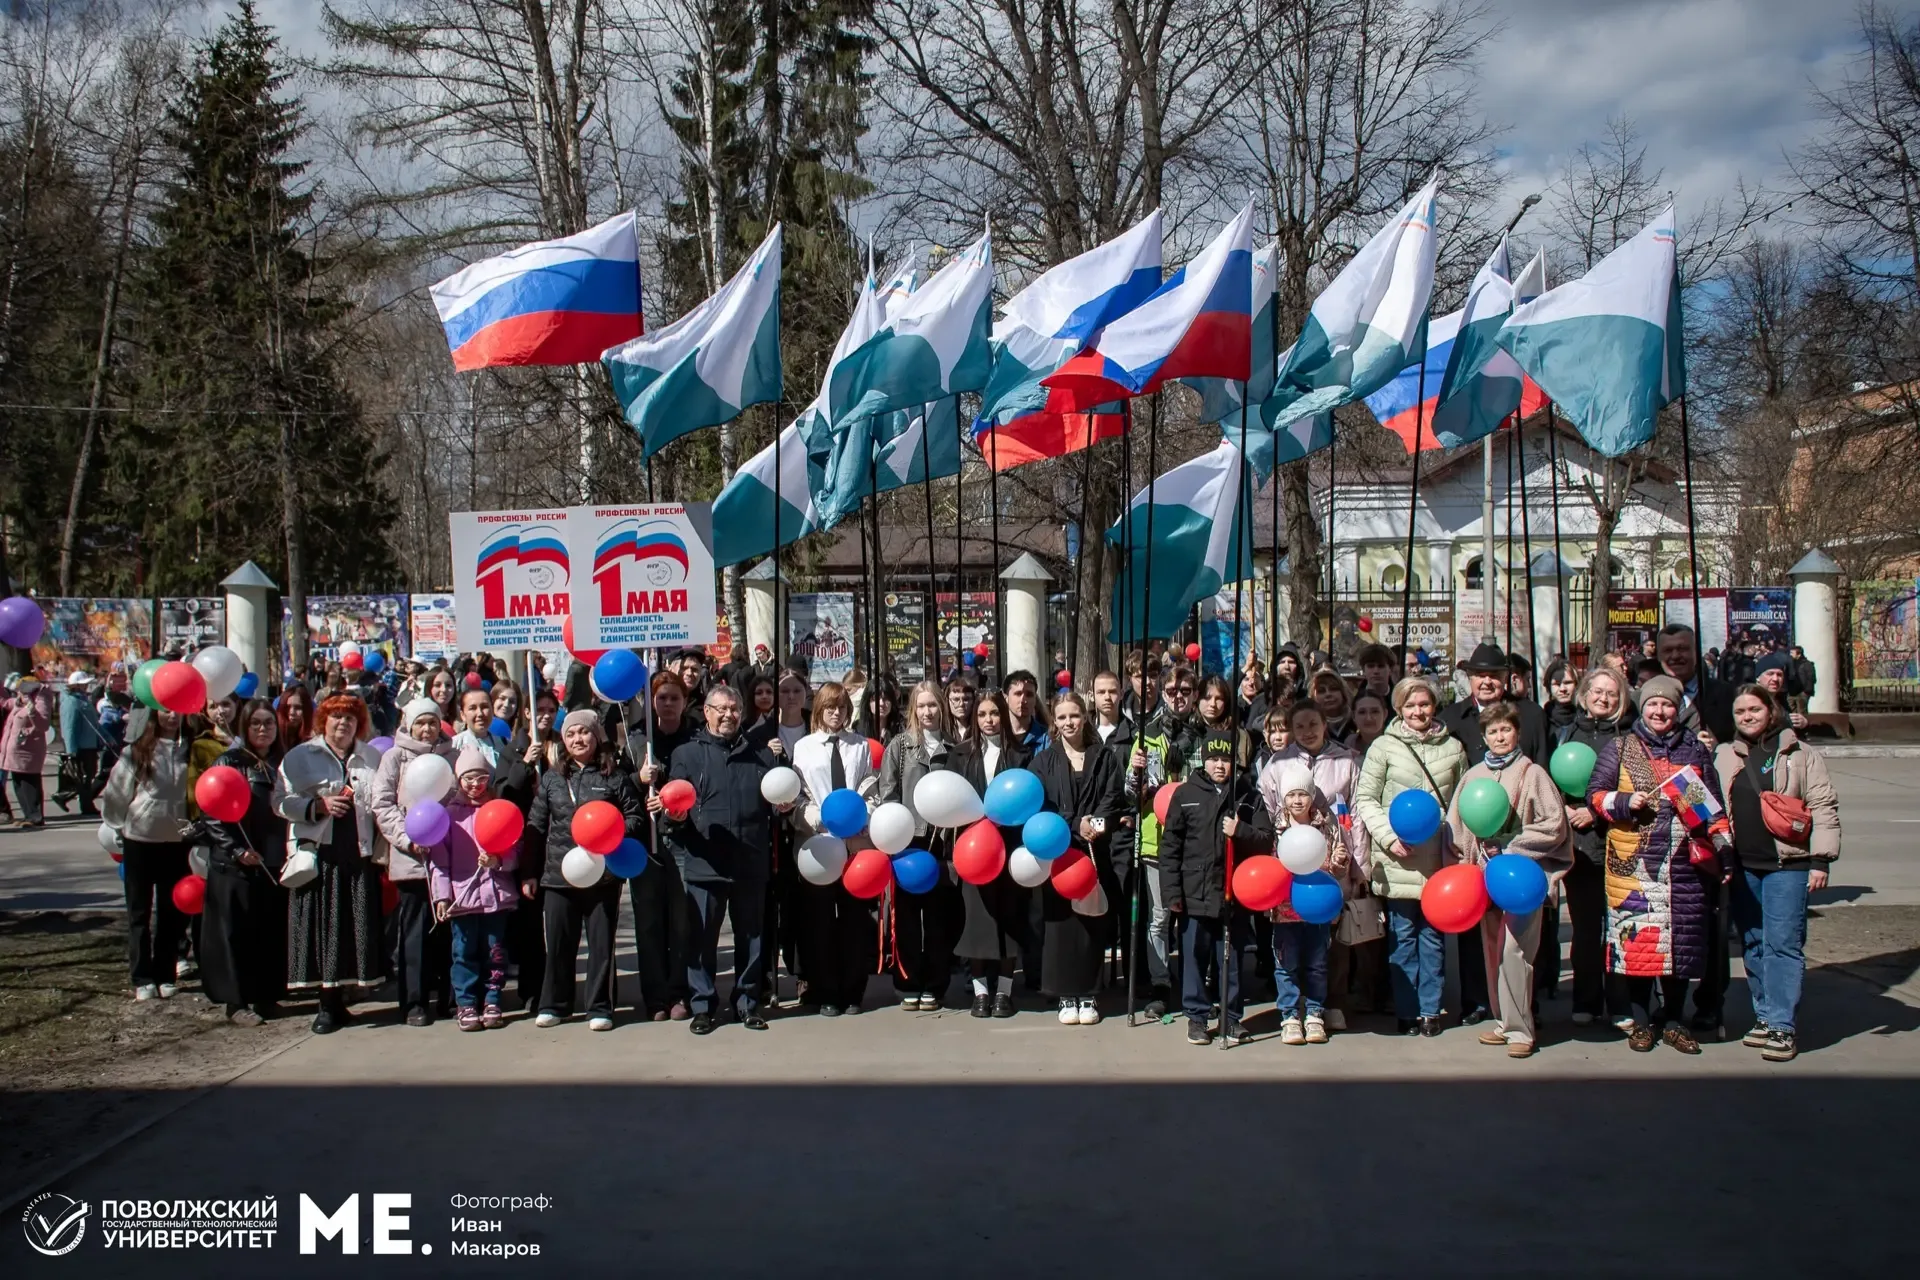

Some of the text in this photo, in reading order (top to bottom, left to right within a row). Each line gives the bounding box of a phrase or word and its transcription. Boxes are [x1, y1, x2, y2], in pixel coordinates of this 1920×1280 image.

[595, 507, 685, 517] ПРОФСОЮЗЫ РОССИИ
[477, 513, 566, 523] ПРОФСОЮЗЫ РОССИИ
[476, 566, 570, 619] 1 МАЯ
[592, 562, 688, 617] 1 МАЯ
[600, 615, 663, 625] СОЛИДАРНОСТЬ
[1608, 607, 1658, 625] МОЖЕТ БЫТЬ!
[483, 618, 545, 627] СОЛИДАРНОСТЬ
[600, 625, 648, 633] ТРУДЯЩИХСЯ
[652, 623, 680, 631] РОССИИ
[1388, 625, 1395, 635] 3
[1420, 625, 1441, 635] 000
[484, 636, 528, 645] ЕДИНСТВО
[601, 632, 689, 643] ЕДИНСТВО СТРАНЫ!
[1208, 739, 1231, 754] RUN
